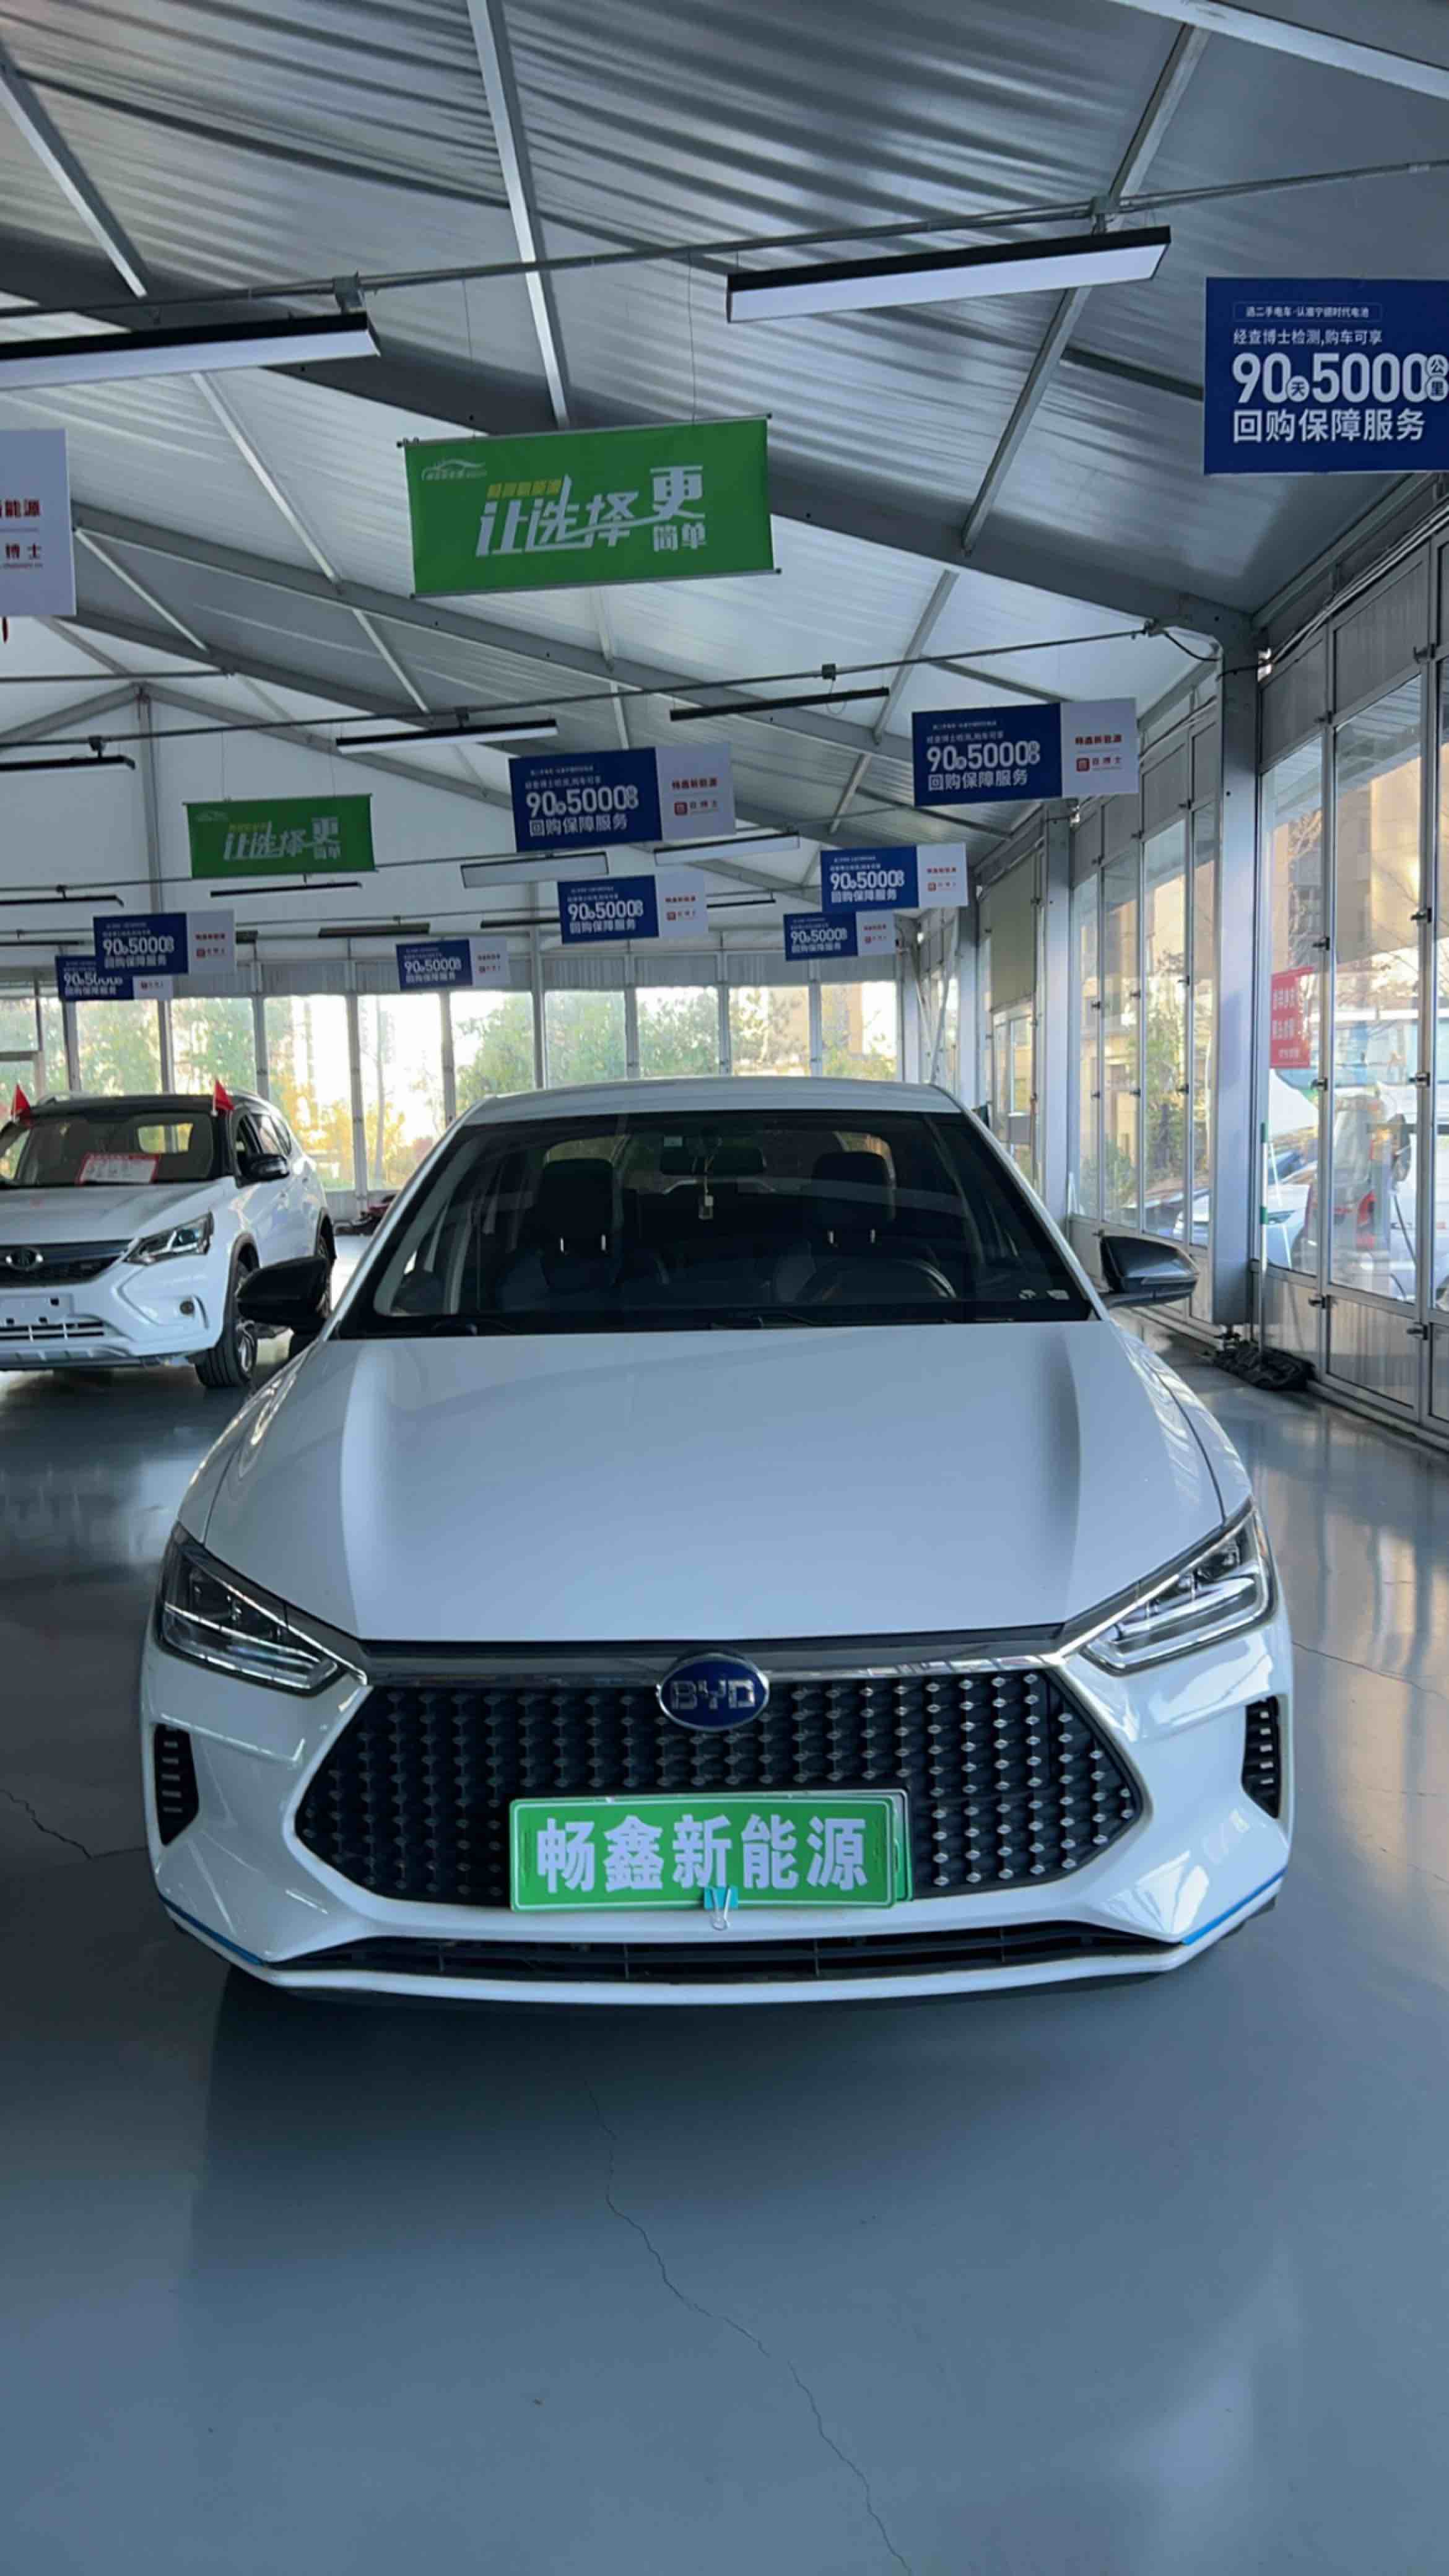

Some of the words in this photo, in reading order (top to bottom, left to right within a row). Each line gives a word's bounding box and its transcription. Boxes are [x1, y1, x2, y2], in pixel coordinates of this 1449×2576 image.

[1233, 409, 1425, 443] 回购保障服务
[928, 769, 1028, 791] 回购保障服务
[671, 1679, 756, 1710] BYD
[536, 1814, 868, 1894] 畅鑫新能源
